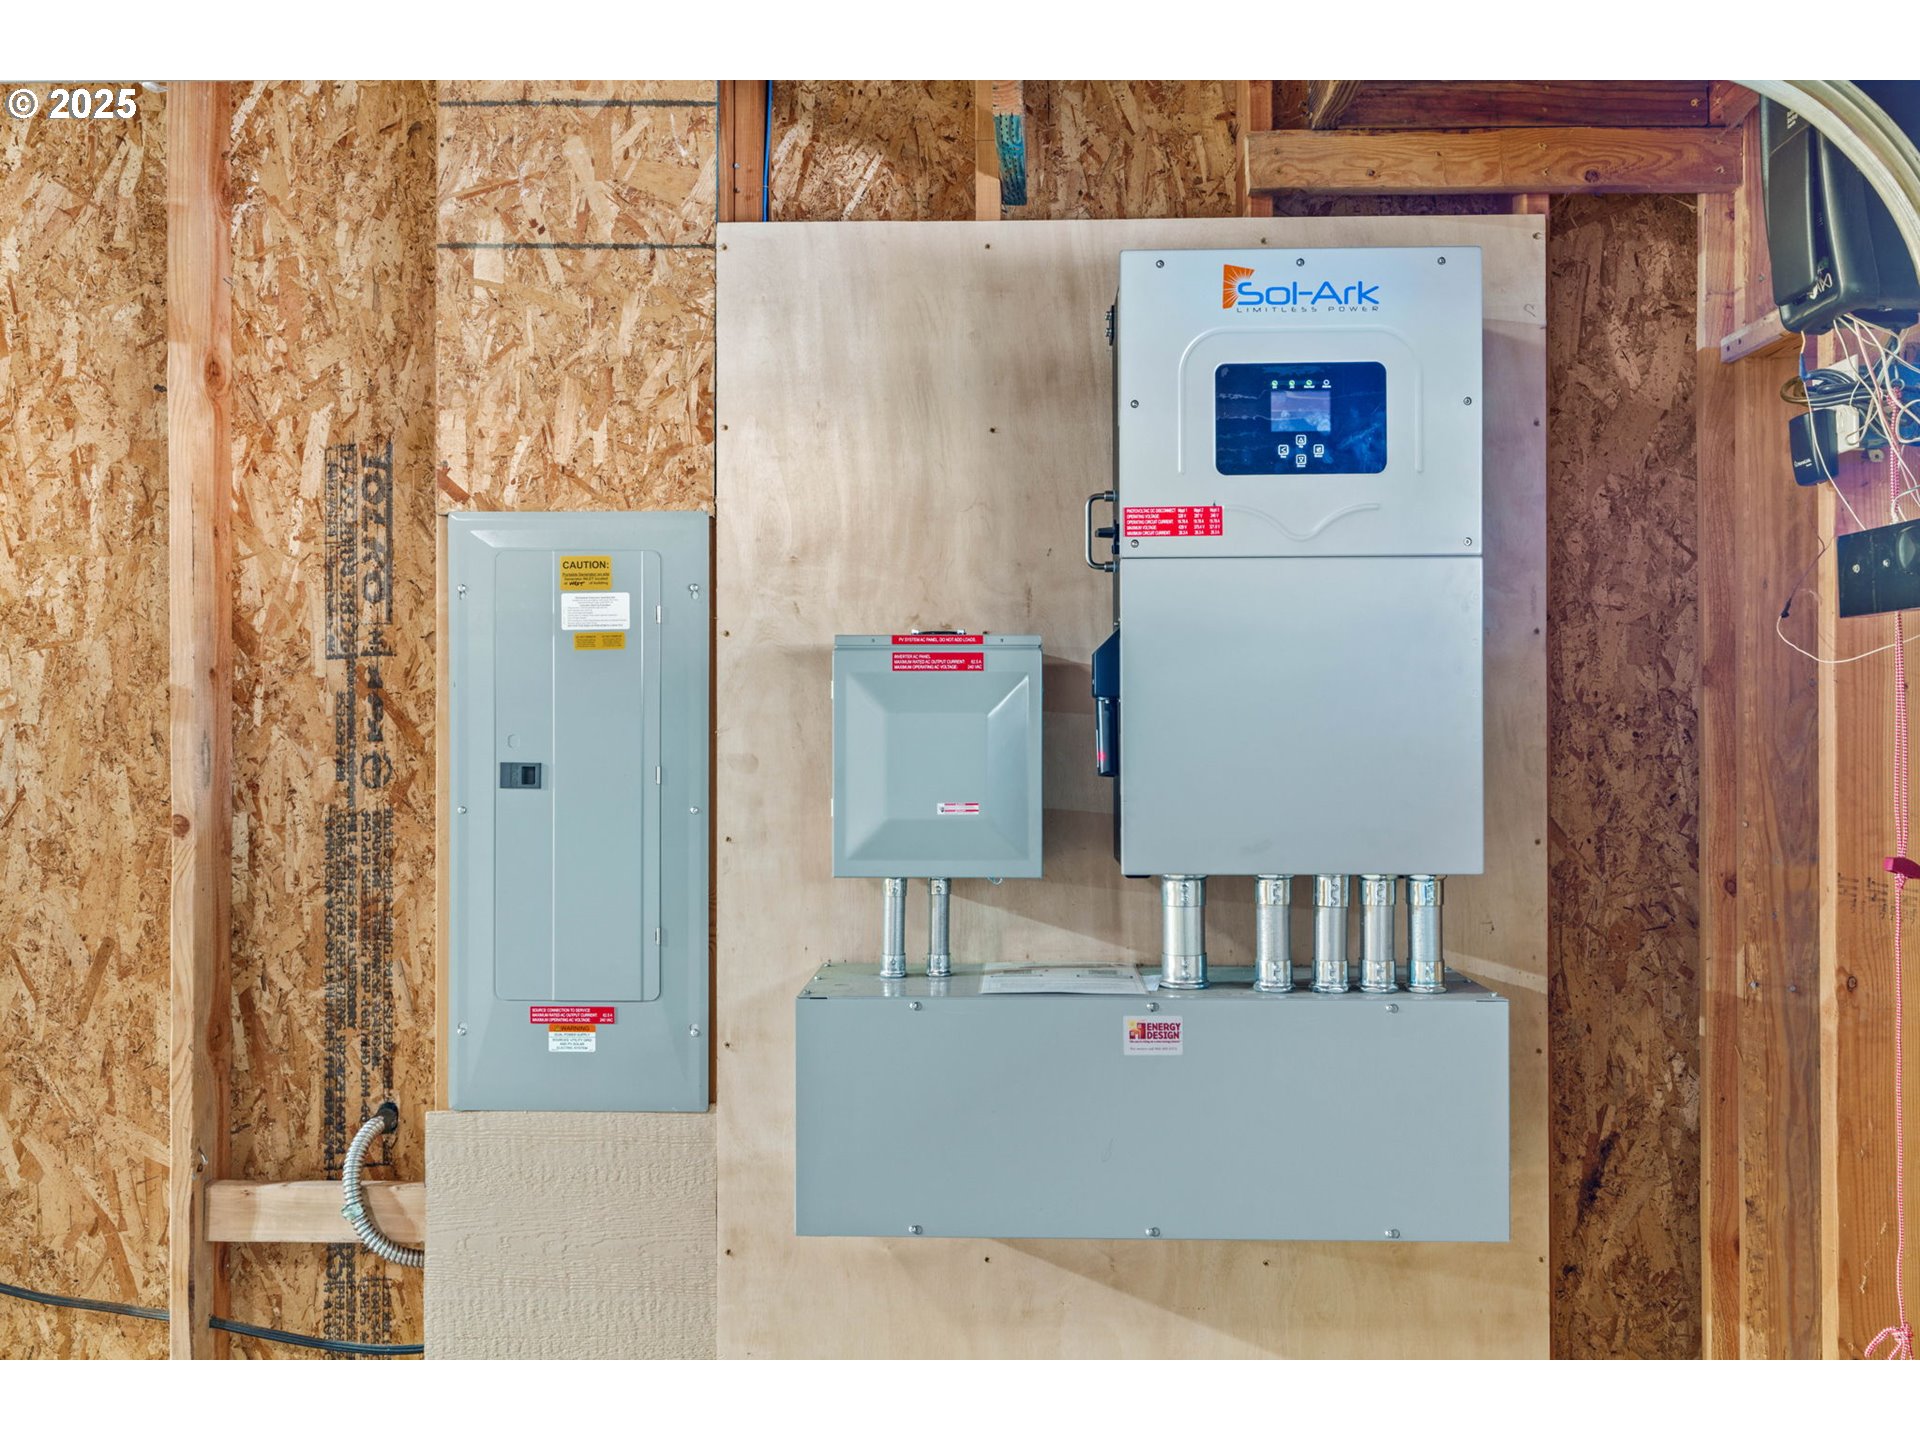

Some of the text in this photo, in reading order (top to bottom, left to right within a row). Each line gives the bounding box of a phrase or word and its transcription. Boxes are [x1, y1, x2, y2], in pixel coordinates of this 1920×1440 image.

[1237, 281, 1379, 305] Sol-Ark
[562, 560, 609, 569] CAUTION:
[1147, 1022, 1181, 1031] ENERGY
[1147, 1032, 1180, 1040] DESIGN
